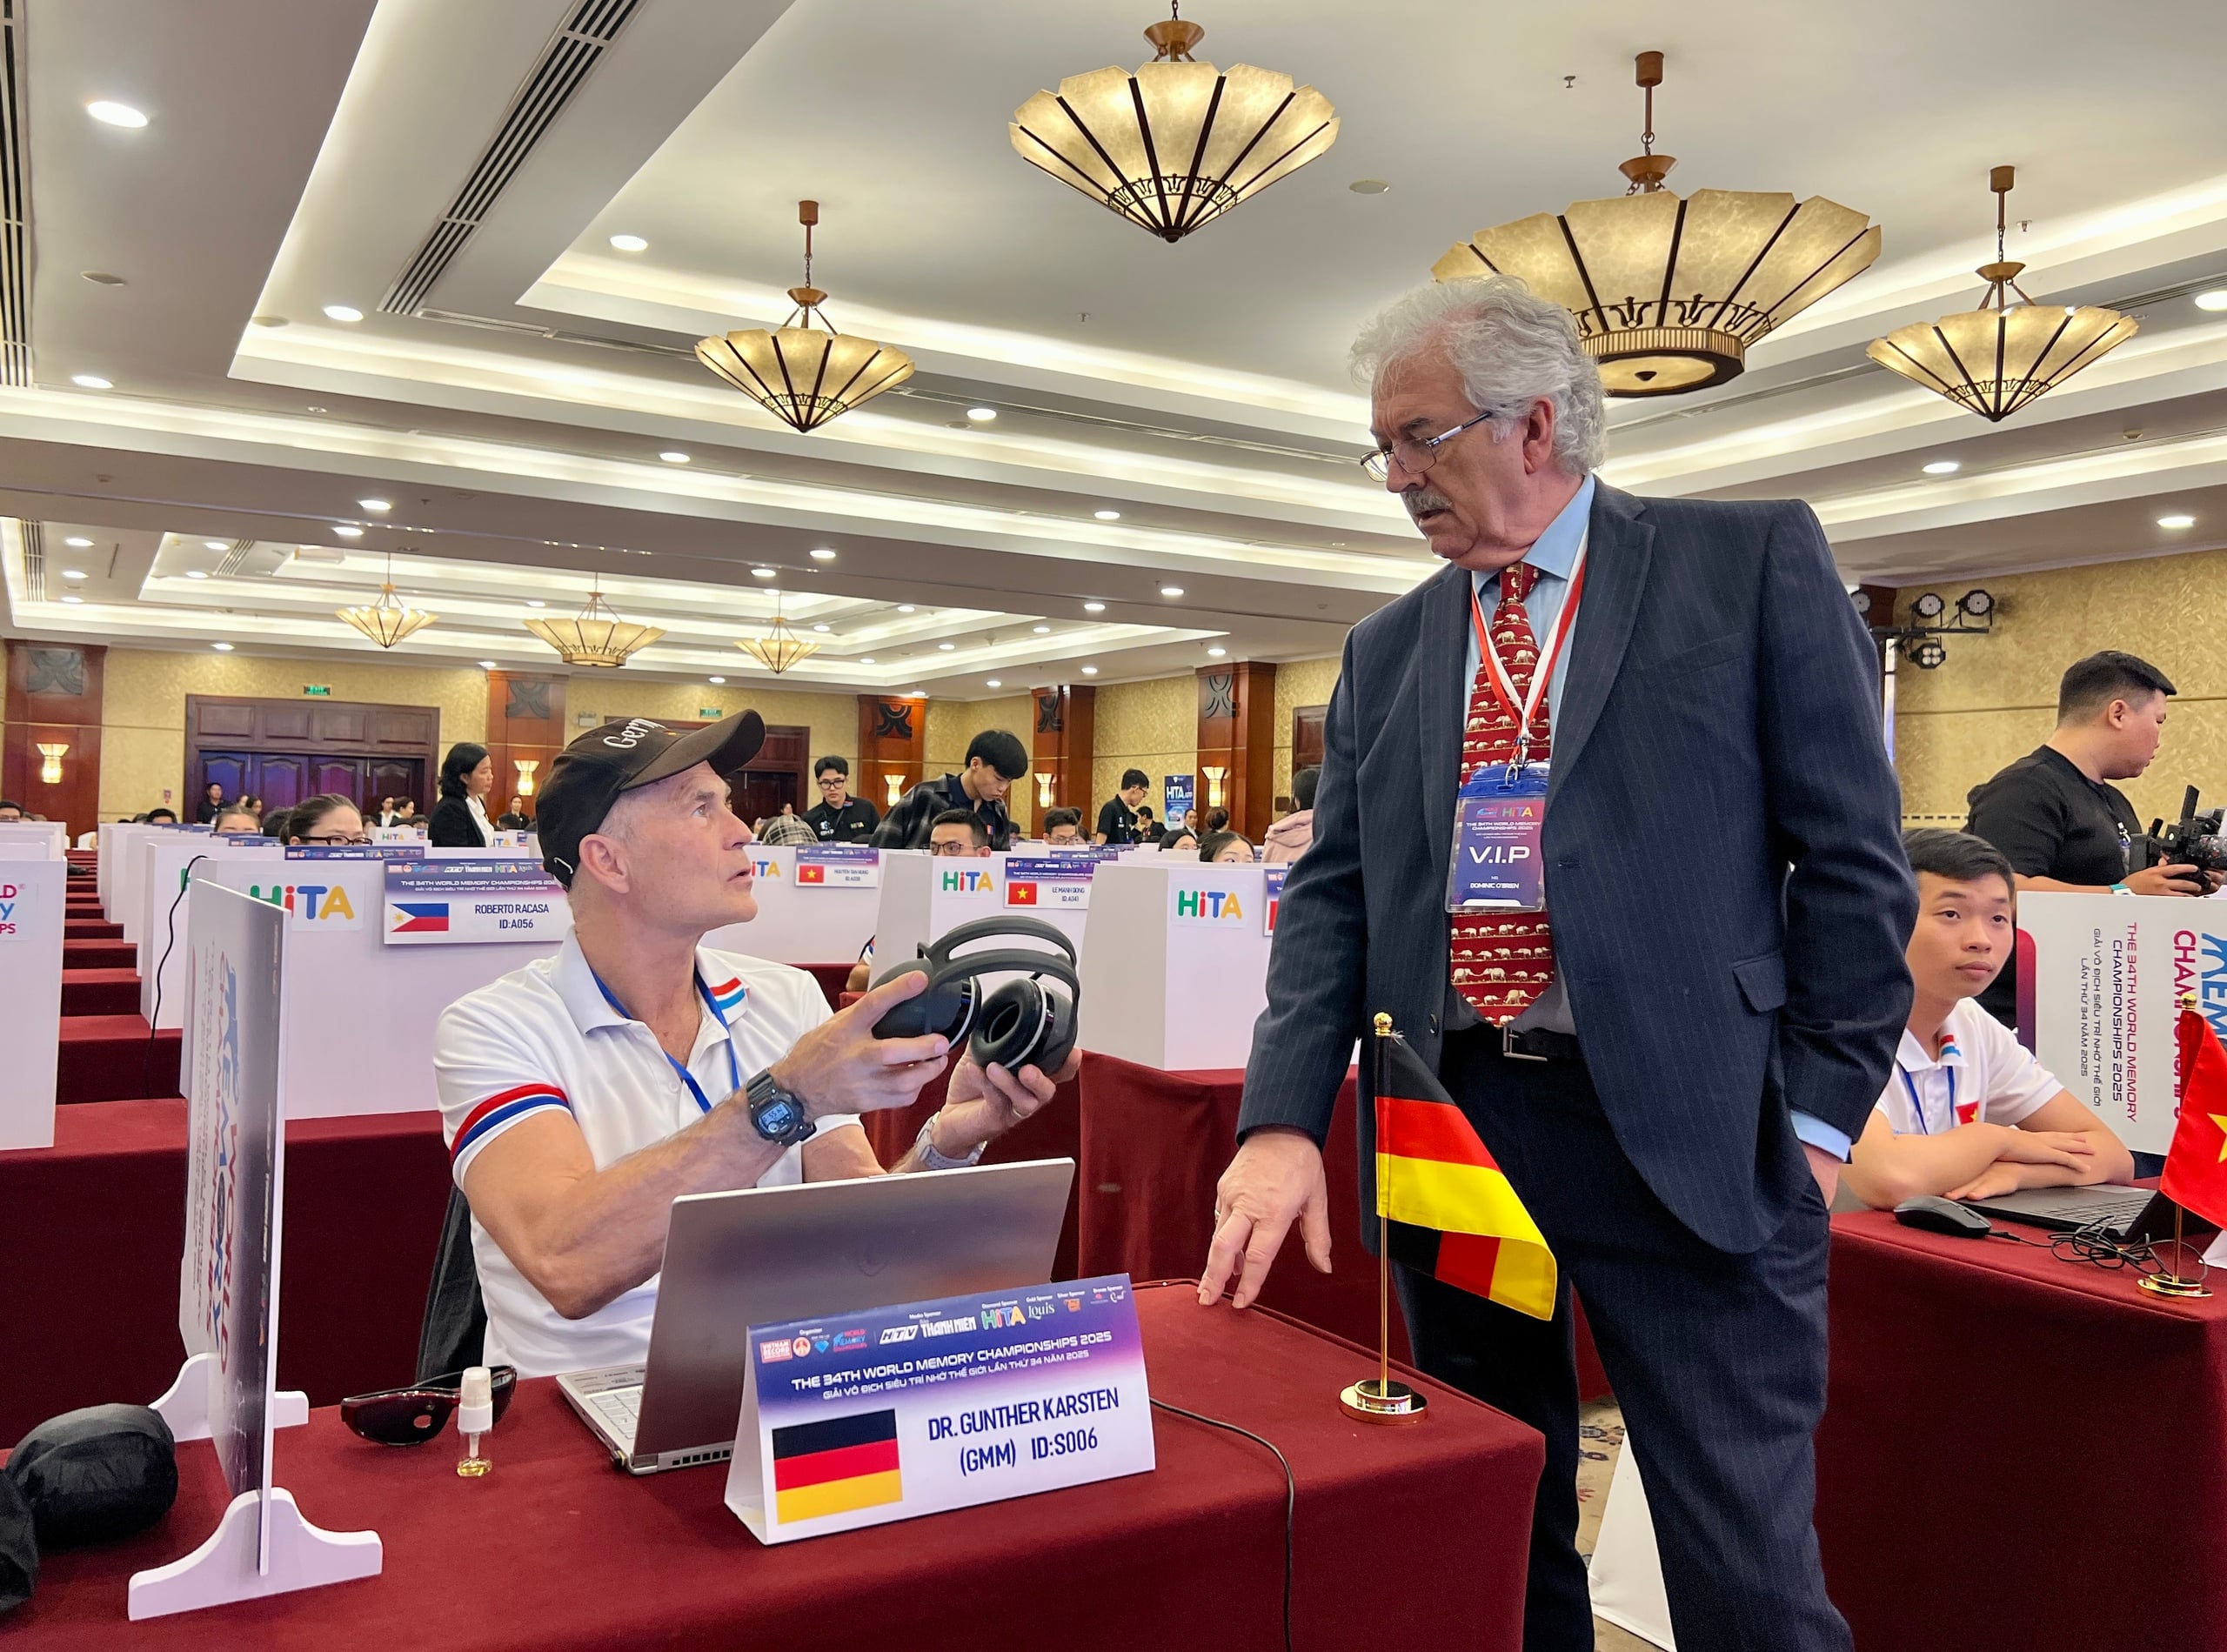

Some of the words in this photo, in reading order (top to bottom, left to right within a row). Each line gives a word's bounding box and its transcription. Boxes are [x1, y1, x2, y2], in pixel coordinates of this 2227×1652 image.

[751, 860, 781, 877] iTA
[1469, 846, 1530, 864] V.I.P
[942, 871, 993, 892] HiTA
[250, 885, 355, 920] HiTA
[475, 904, 514, 914] ROBERTO
[515, 904, 549, 913] RACASA
[1177, 890, 1242, 920] HiTA
[499, 919, 533, 929] ID:A056
[2127, 922, 2137, 951] THE
[2093, 950, 2102, 966] VÔ
[2127, 954, 2137, 993] 34TH
[2081, 1007, 2088, 1020] 34
[2093, 993, 2102, 1017] SIÊU
[2113, 940, 2123, 1060] CHAMPIONSHIPS
[2081, 1022, 2090, 1047] NĂM
[2093, 1020, 2102, 1036] TRÍ
[2127, 998, 2137, 1052] WORLD
[2113, 1063, 2123, 1101] 2025
[2127, 1055, 2137, 1122] MEMORY
[980, 1305, 1027, 1330] HiTA
[880, 1327, 917, 1343] HTV
[791, 1375, 820, 1390] THE
[823, 1369, 860, 1386] 34TH
[863, 1361, 913, 1379] WORLD
[916, 1352, 974, 1371] MEMORY
[977, 1336, 1078, 1361] CHAMPIONSHIPS
[1080, 1330, 1113, 1346] 2025
[844, 1384, 859, 1395] VÔ
[1030, 1356, 1042, 1367] 34
[1043, 1353, 1065, 1365] NĂM
[1066, 1349, 1089, 1361] 2025
[928, 1416, 958, 1441] DR.
[960, 1401, 1041, 1435] GUNTHER
[1043, 1387, 1120, 1421] KARSTEN
[960, 1438, 1016, 1477] (GMM)
[1031, 1426, 1098, 1460] ID:S006
